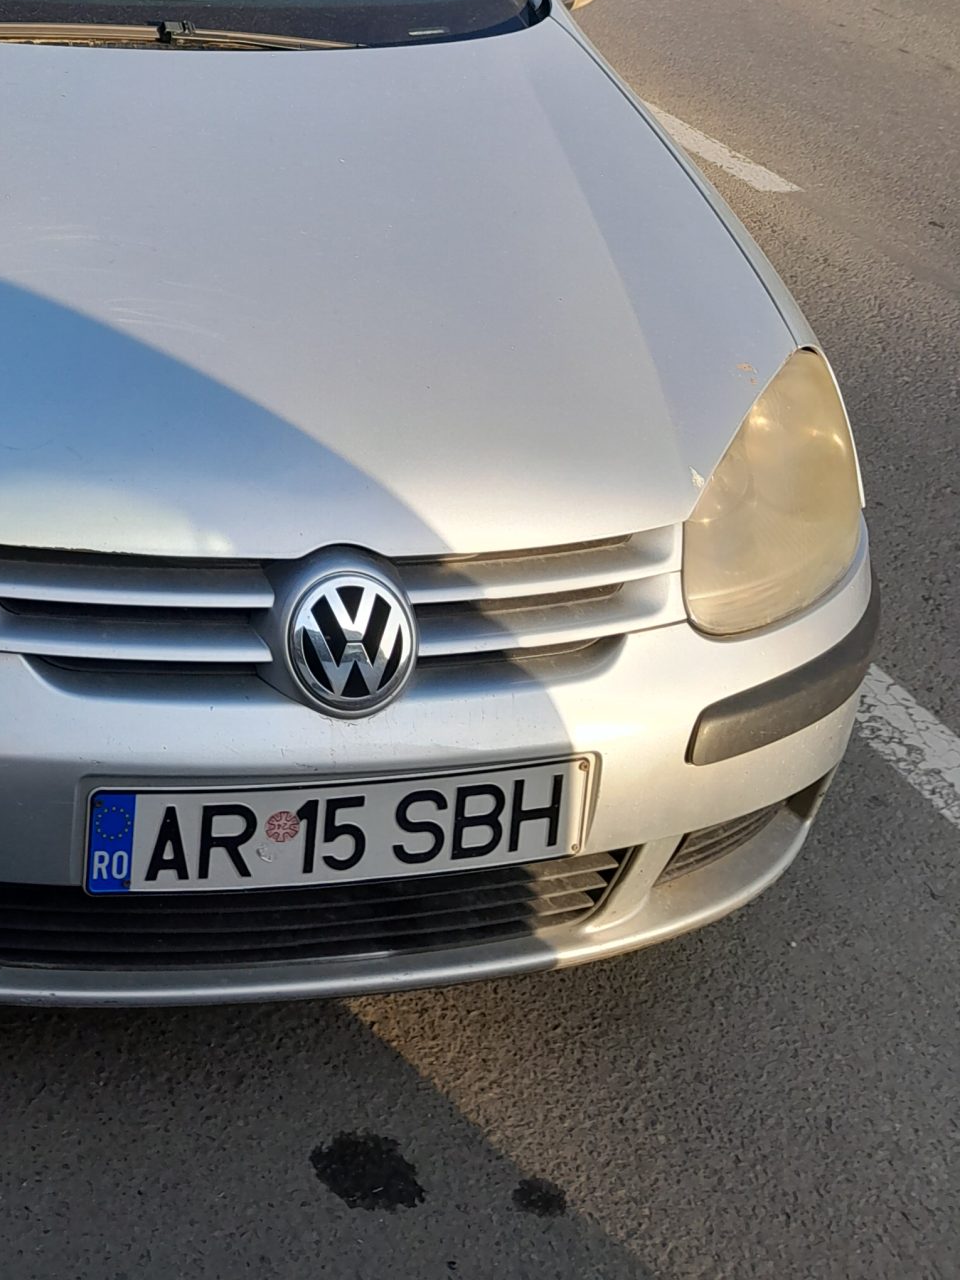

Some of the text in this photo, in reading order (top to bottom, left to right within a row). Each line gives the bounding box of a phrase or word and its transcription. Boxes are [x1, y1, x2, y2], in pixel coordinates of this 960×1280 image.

[144, 774, 563, 881] AR 15 SBH
[93, 849, 129, 880] RO
